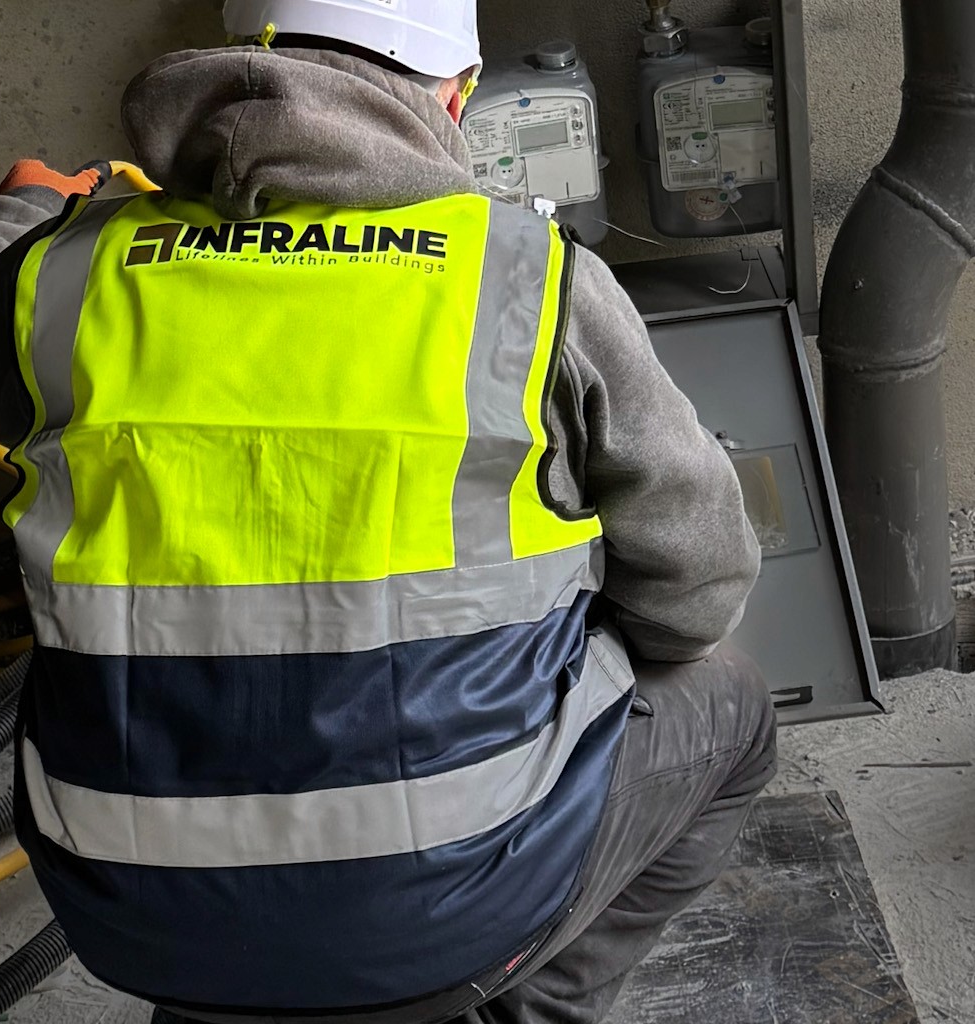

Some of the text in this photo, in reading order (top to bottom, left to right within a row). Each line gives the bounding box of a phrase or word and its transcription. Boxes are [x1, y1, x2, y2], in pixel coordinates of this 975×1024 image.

[177, 221, 447, 258] INFRALINE
[175, 249, 445, 273] Lifelines Within Buildings
